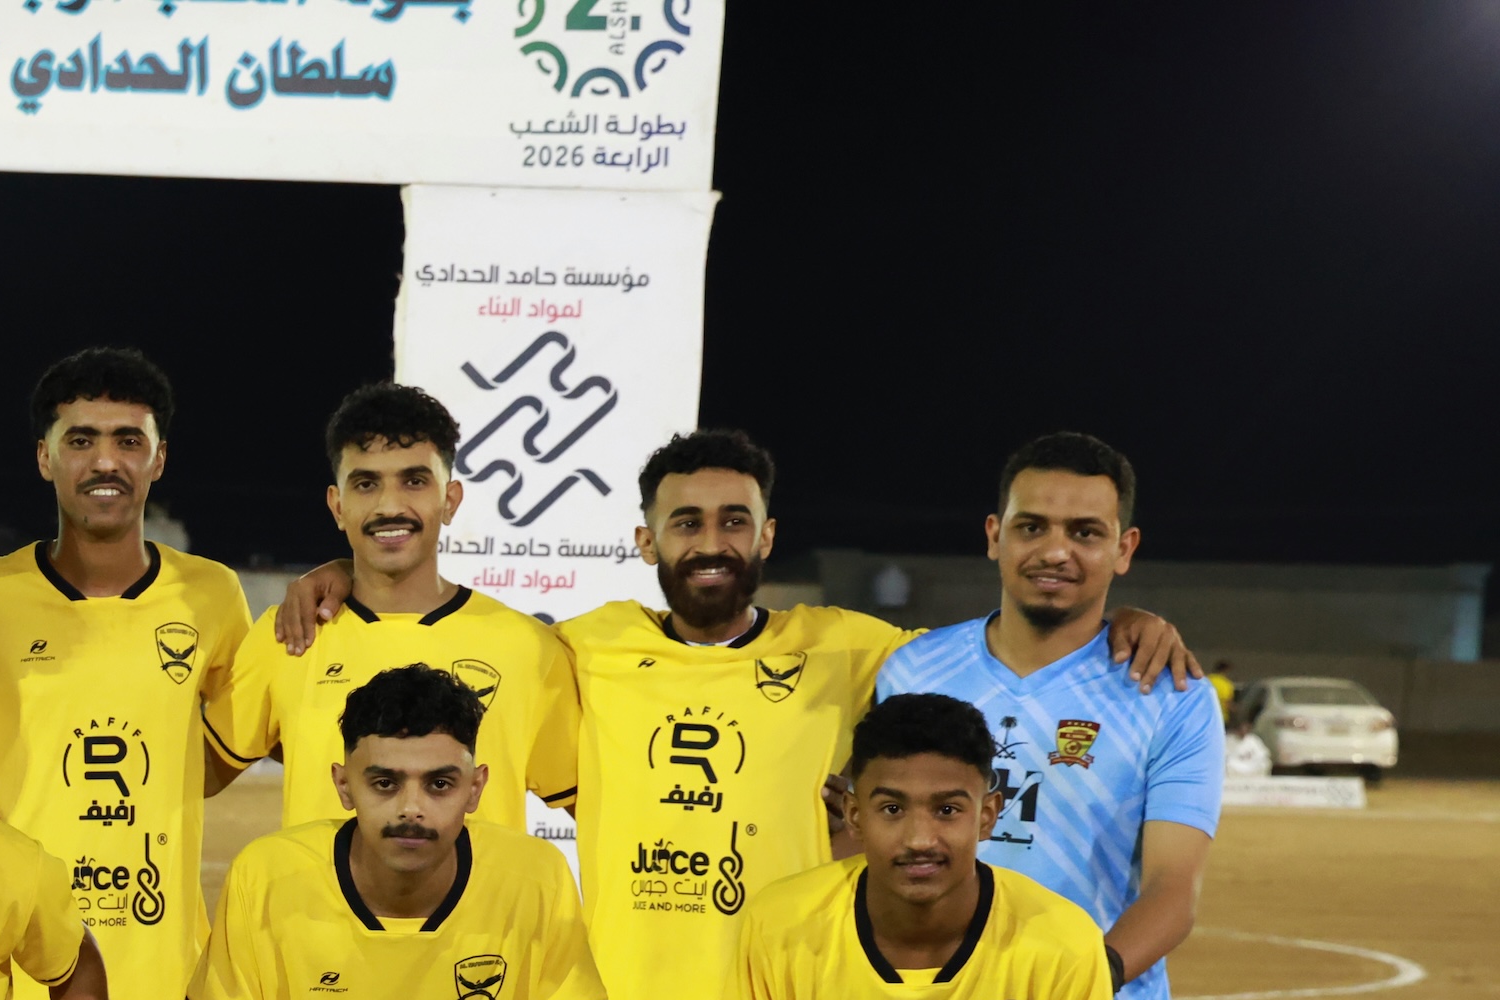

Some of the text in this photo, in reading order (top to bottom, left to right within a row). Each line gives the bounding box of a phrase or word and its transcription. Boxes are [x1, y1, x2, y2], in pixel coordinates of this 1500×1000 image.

[609, 1, 627, 55] ALSH
[11, 31, 209, 115] الحدادي
[225, 37, 397, 110] سلطان
[509, 110, 687, 141] بطولة الشعب
[522, 145, 669, 174] الرابعة 2026
[415, 264, 651, 293] مؤسسة حامد الحدادي
[477, 296, 583, 323] لمواد البناء
[500, 537, 550, 557] حامد
[558, 537, 641, 564] مؤسسة
[472, 567, 576, 594] لمواد البناء
[73, 716, 142, 739] RAFIF
[665, 705, 739, 729] RAFIF
[534, 821, 577, 840] سسة
[649, 901, 673, 912] AND
[674, 903, 707, 914] MORE
[82, 917, 127, 927] ND MORE
